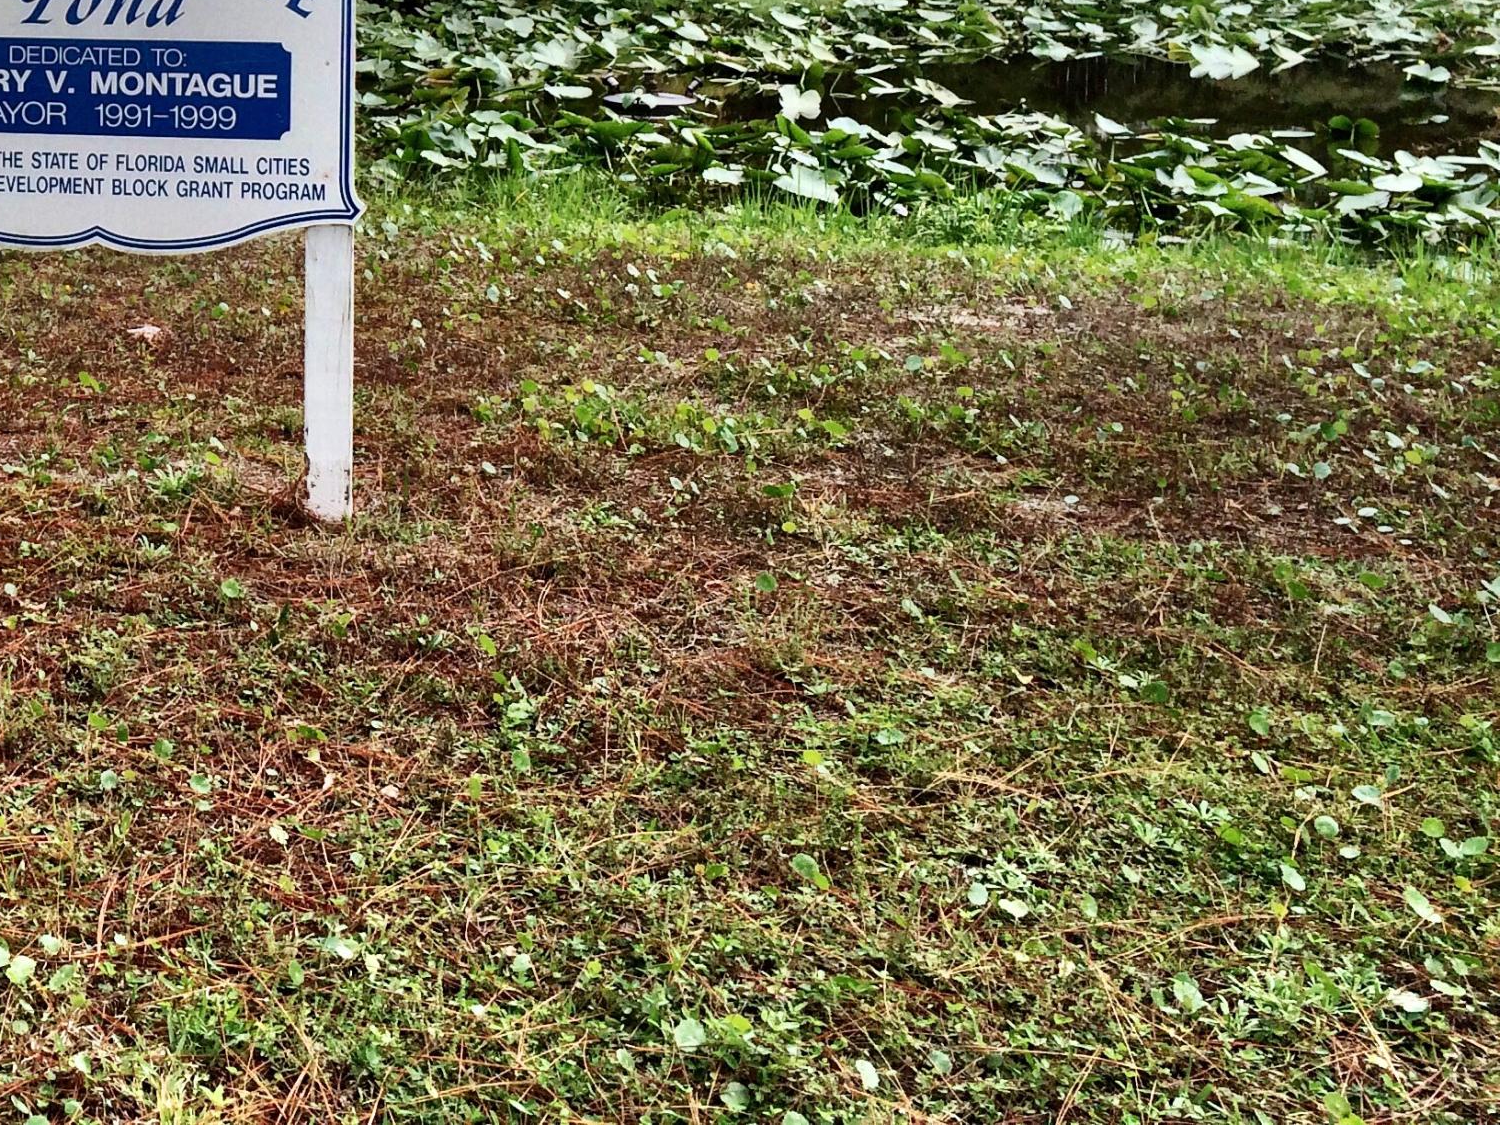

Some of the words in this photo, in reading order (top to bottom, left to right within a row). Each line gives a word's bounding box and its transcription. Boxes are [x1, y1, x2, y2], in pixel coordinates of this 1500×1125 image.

[9, 45, 141, 66] DEDICATED
[150, 48, 187, 67] TO:
[45, 70, 75, 94] V.
[90, 71, 278, 98] MONTAGUE
[94, 103, 237, 130] 1991-1999
[31, 151, 79, 170] STATE
[86, 153, 109, 171] OF
[116, 154, 185, 173] FLORIDA
[193, 156, 249, 174] SMALL
[256, 157, 310, 176] CITIES
[111, 178, 169, 197] BLOCK
[176, 180, 233, 199] GRANT
[241, 182, 325, 201] PROGRAM
